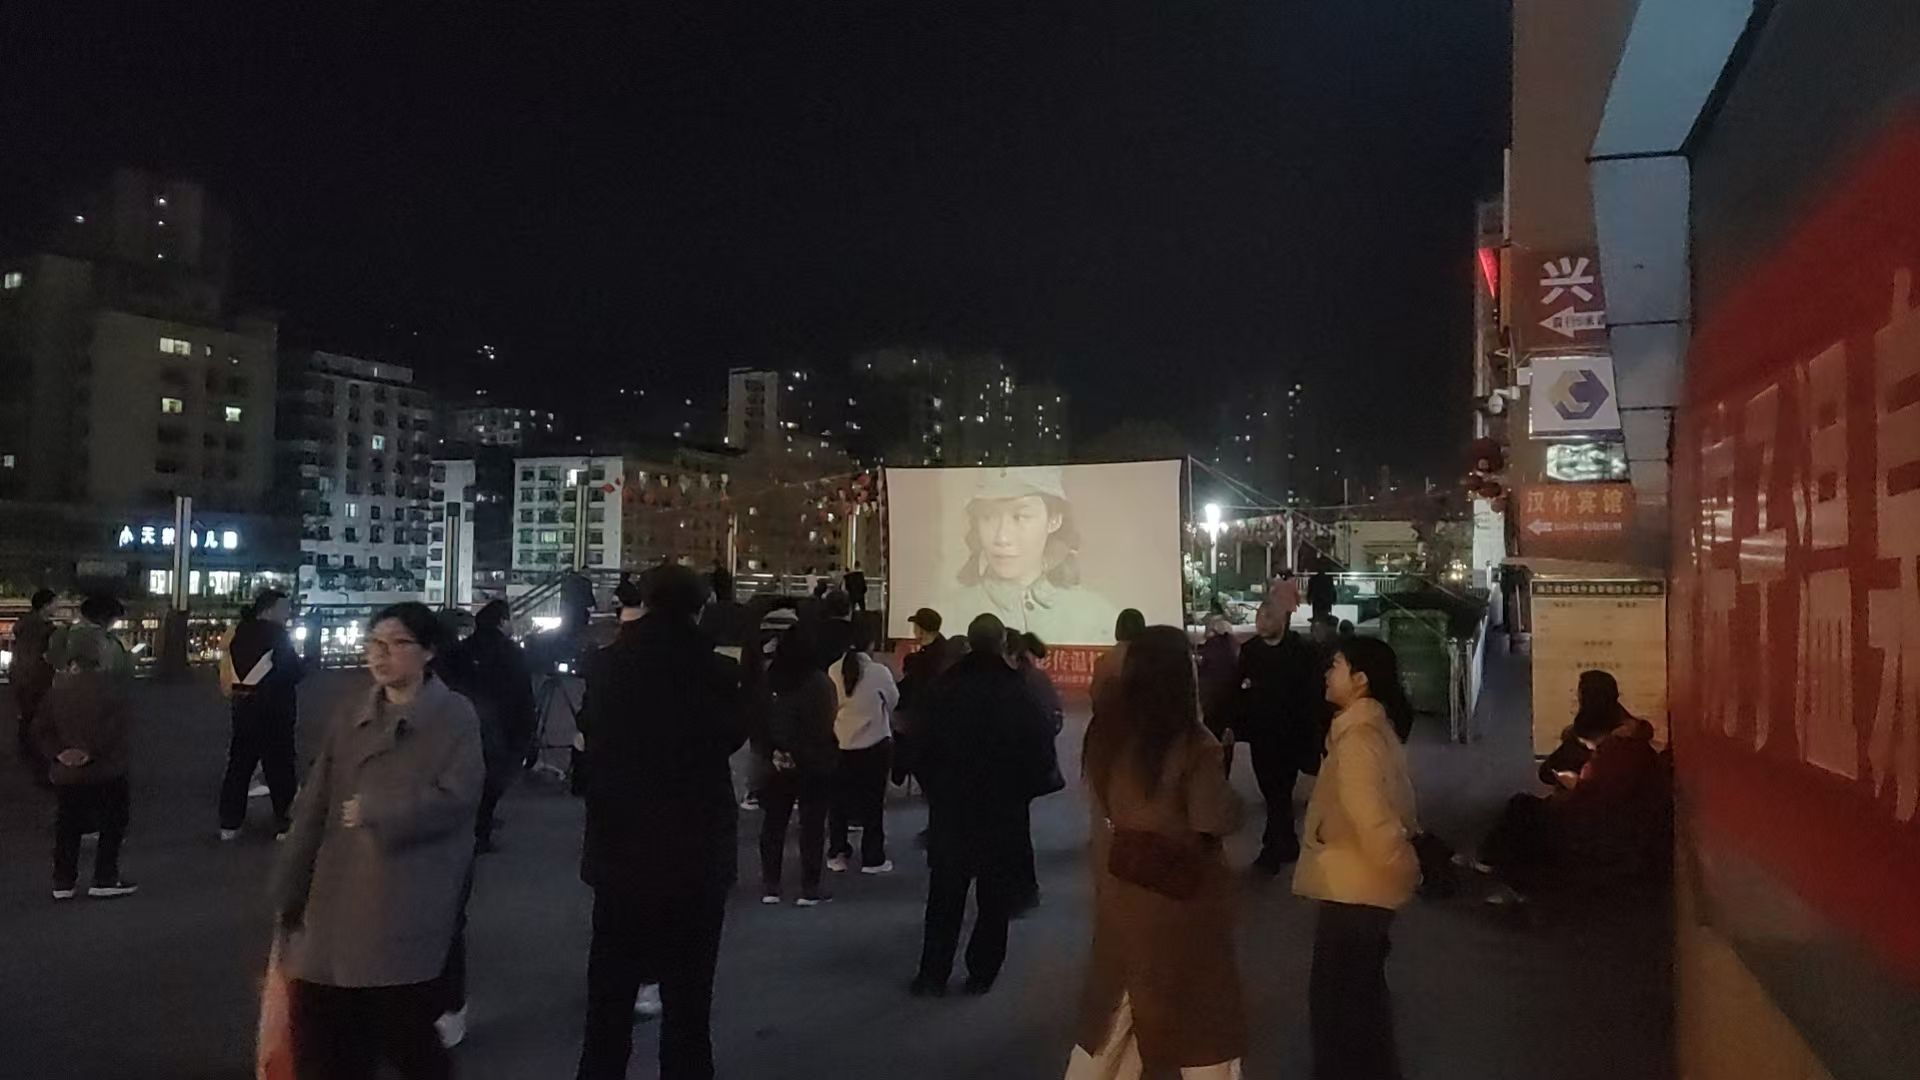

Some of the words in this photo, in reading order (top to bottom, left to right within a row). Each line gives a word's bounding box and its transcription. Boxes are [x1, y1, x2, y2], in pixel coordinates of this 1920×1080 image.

[1540, 256, 1594, 305] 兴
[1527, 488, 1624, 514] 汉竹宾馆
